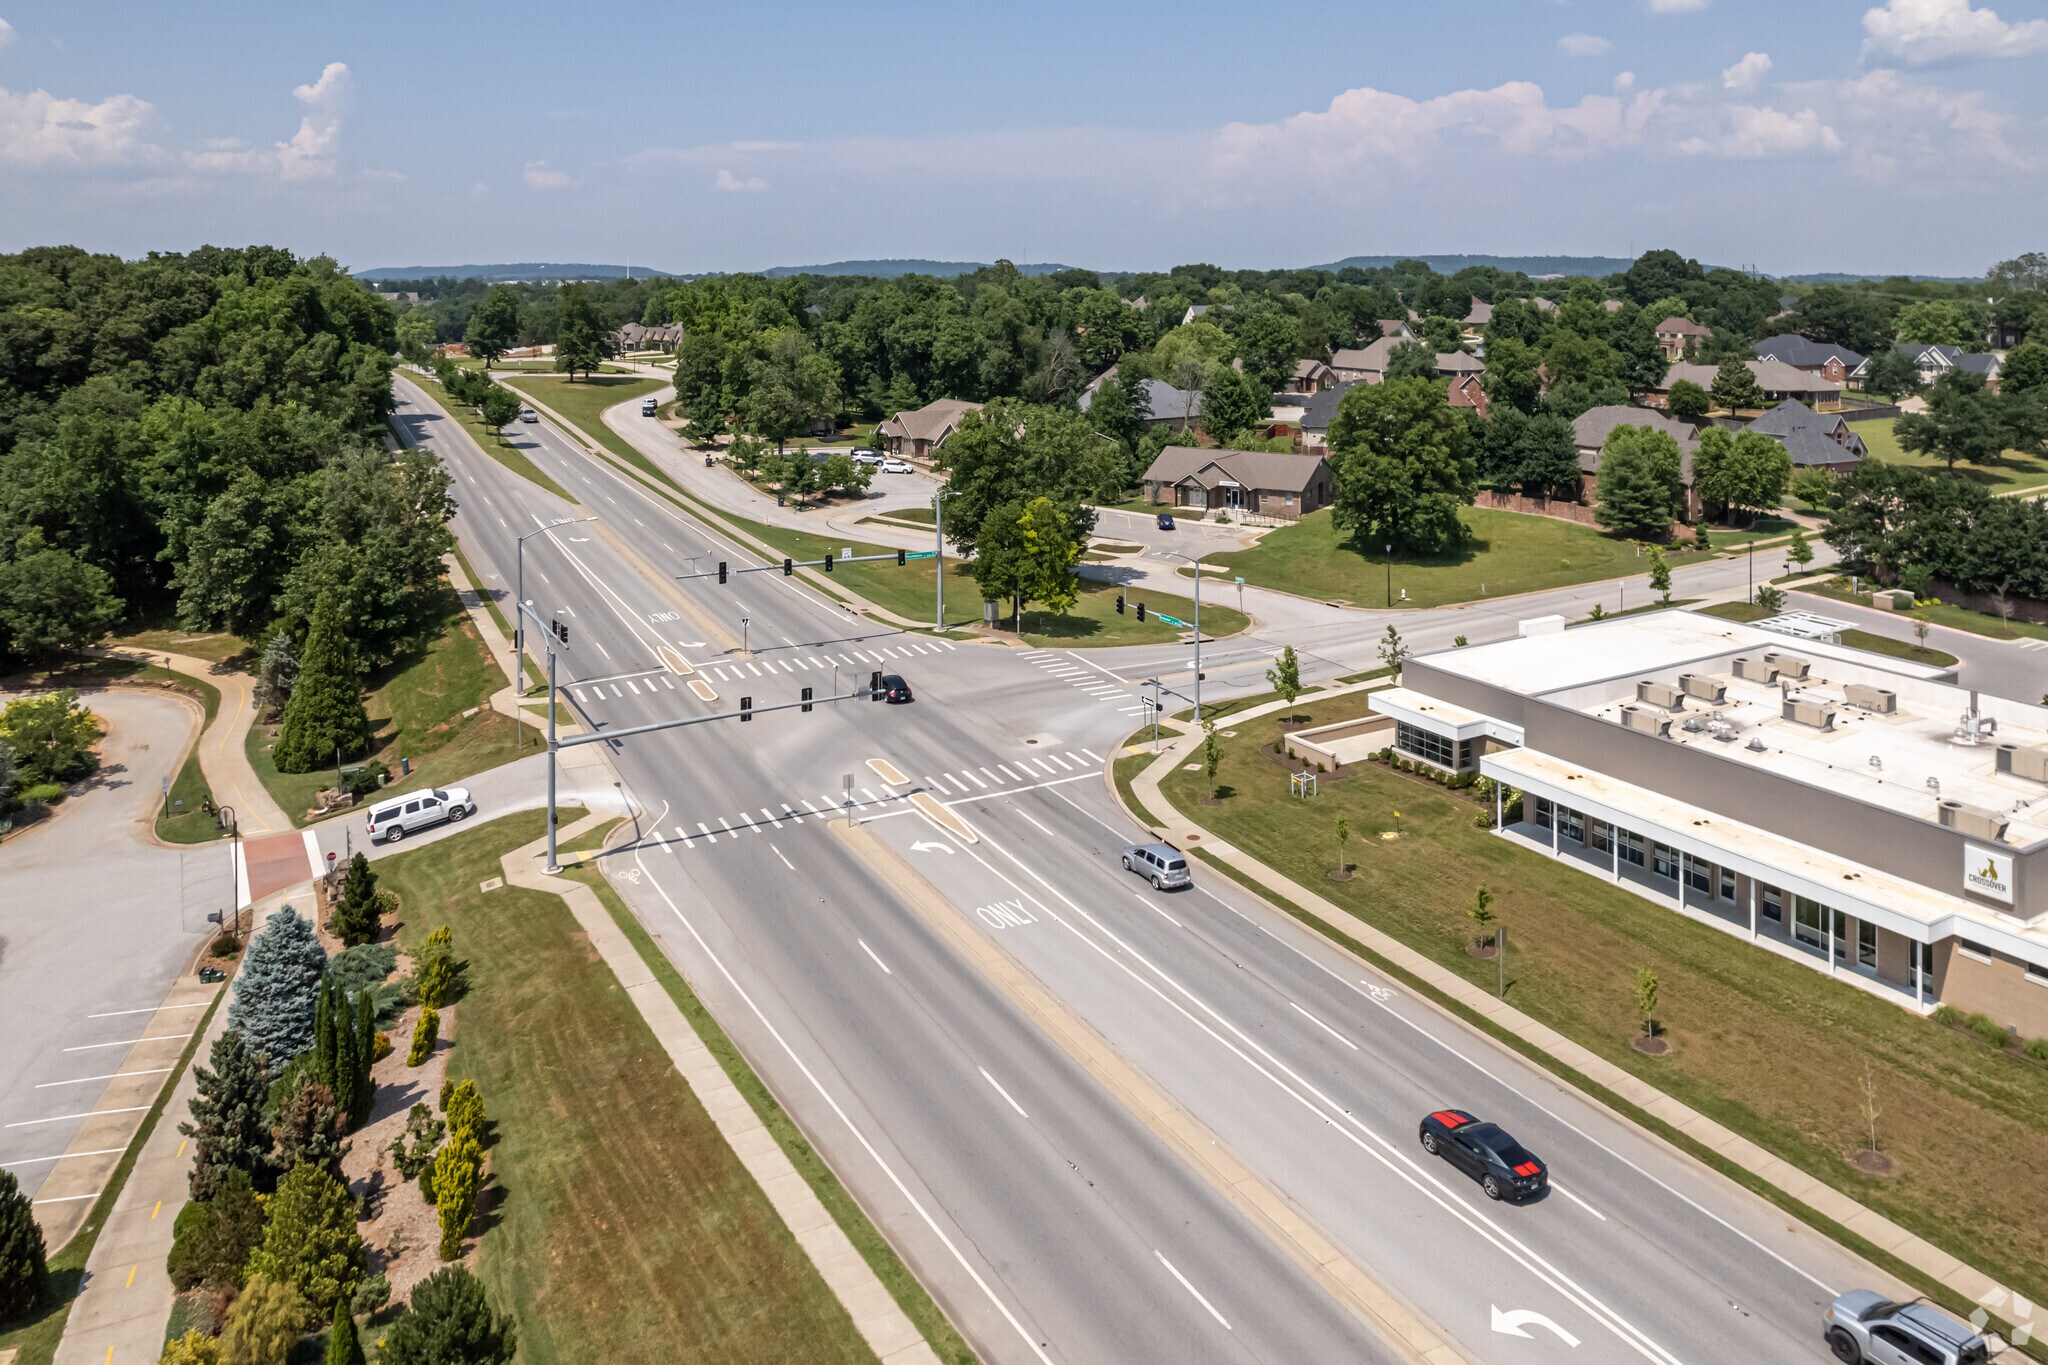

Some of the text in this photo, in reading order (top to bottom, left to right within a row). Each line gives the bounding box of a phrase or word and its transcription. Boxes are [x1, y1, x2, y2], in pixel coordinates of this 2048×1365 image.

[647, 611, 680, 624] ONLY
[1968, 873, 2007, 893] CROSSOVER
[976, 898, 1039, 930] ONLY
